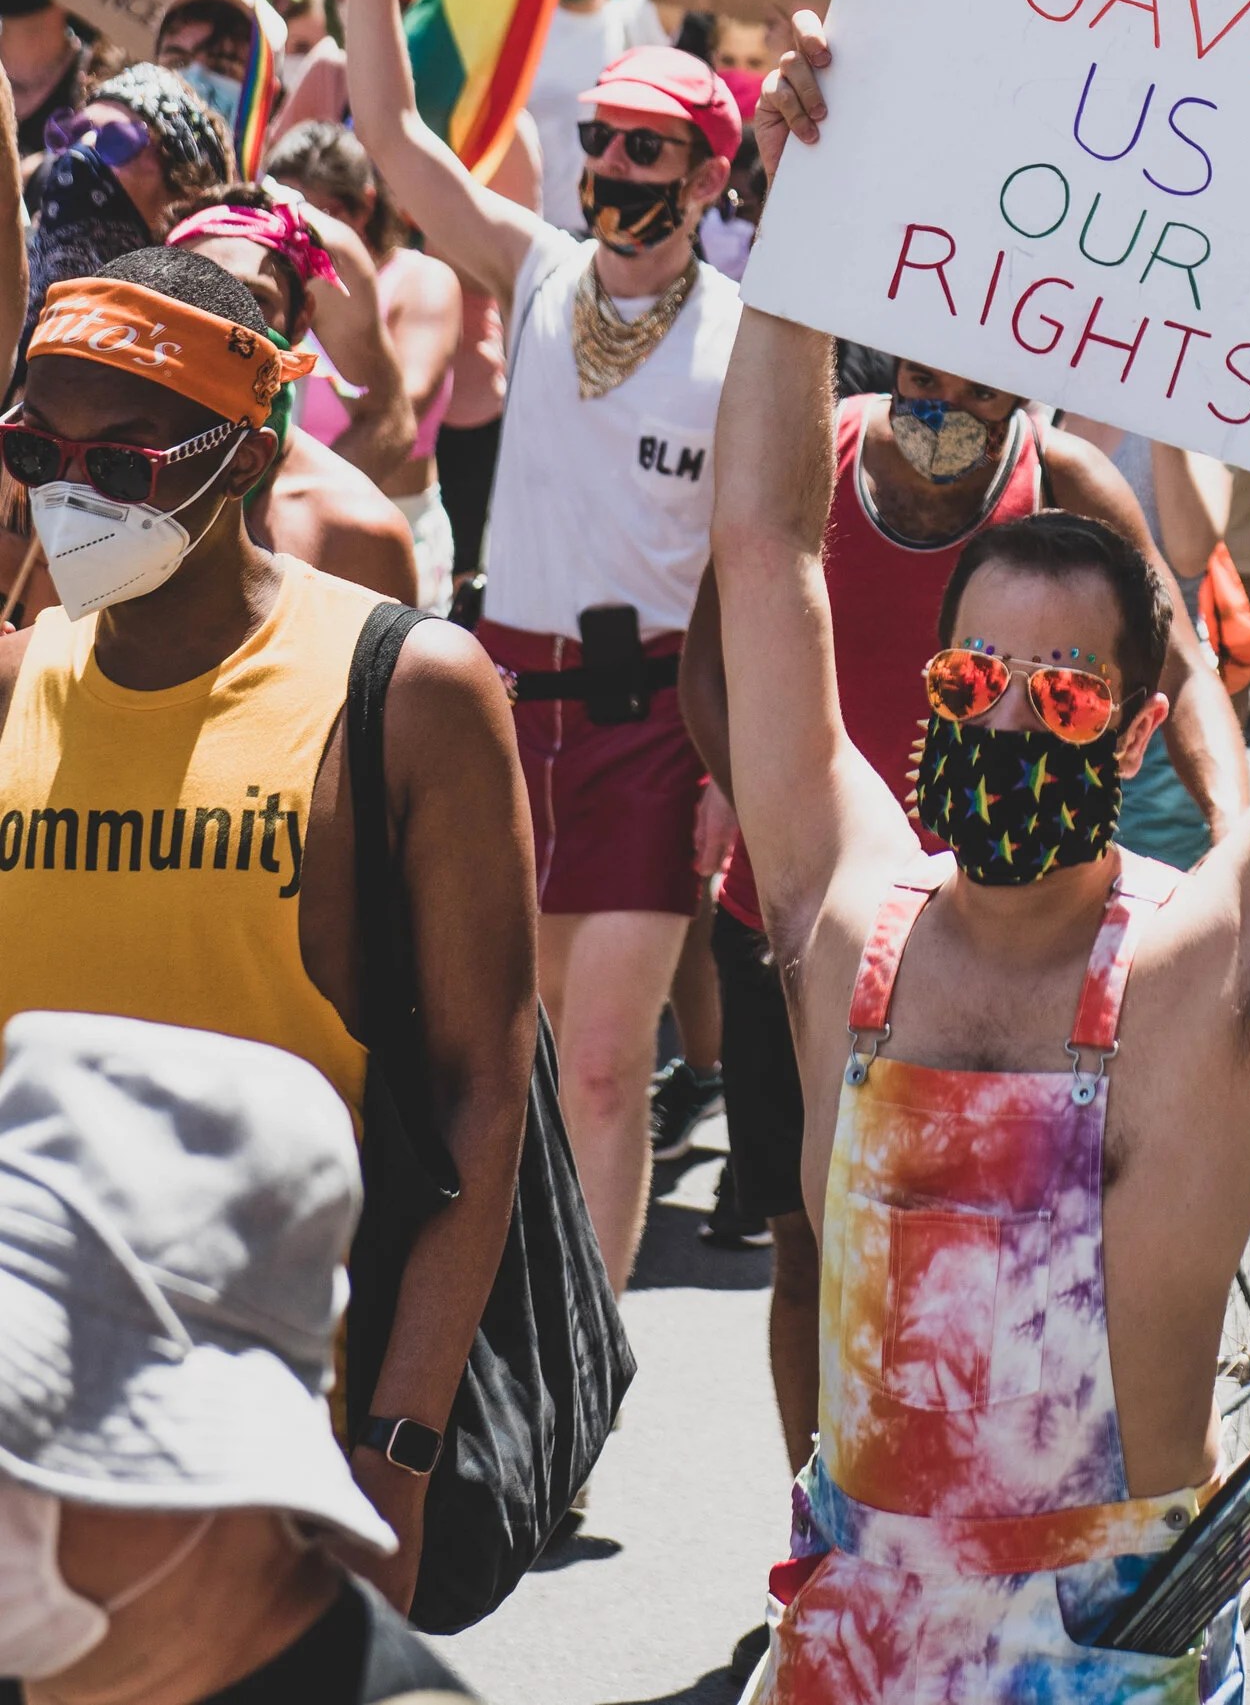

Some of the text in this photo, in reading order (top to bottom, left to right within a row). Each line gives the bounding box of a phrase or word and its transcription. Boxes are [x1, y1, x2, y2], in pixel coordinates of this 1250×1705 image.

[1073, 61, 1218, 197] US
[999, 162, 1212, 311] OUR
[639, 435, 706, 483] BLM
